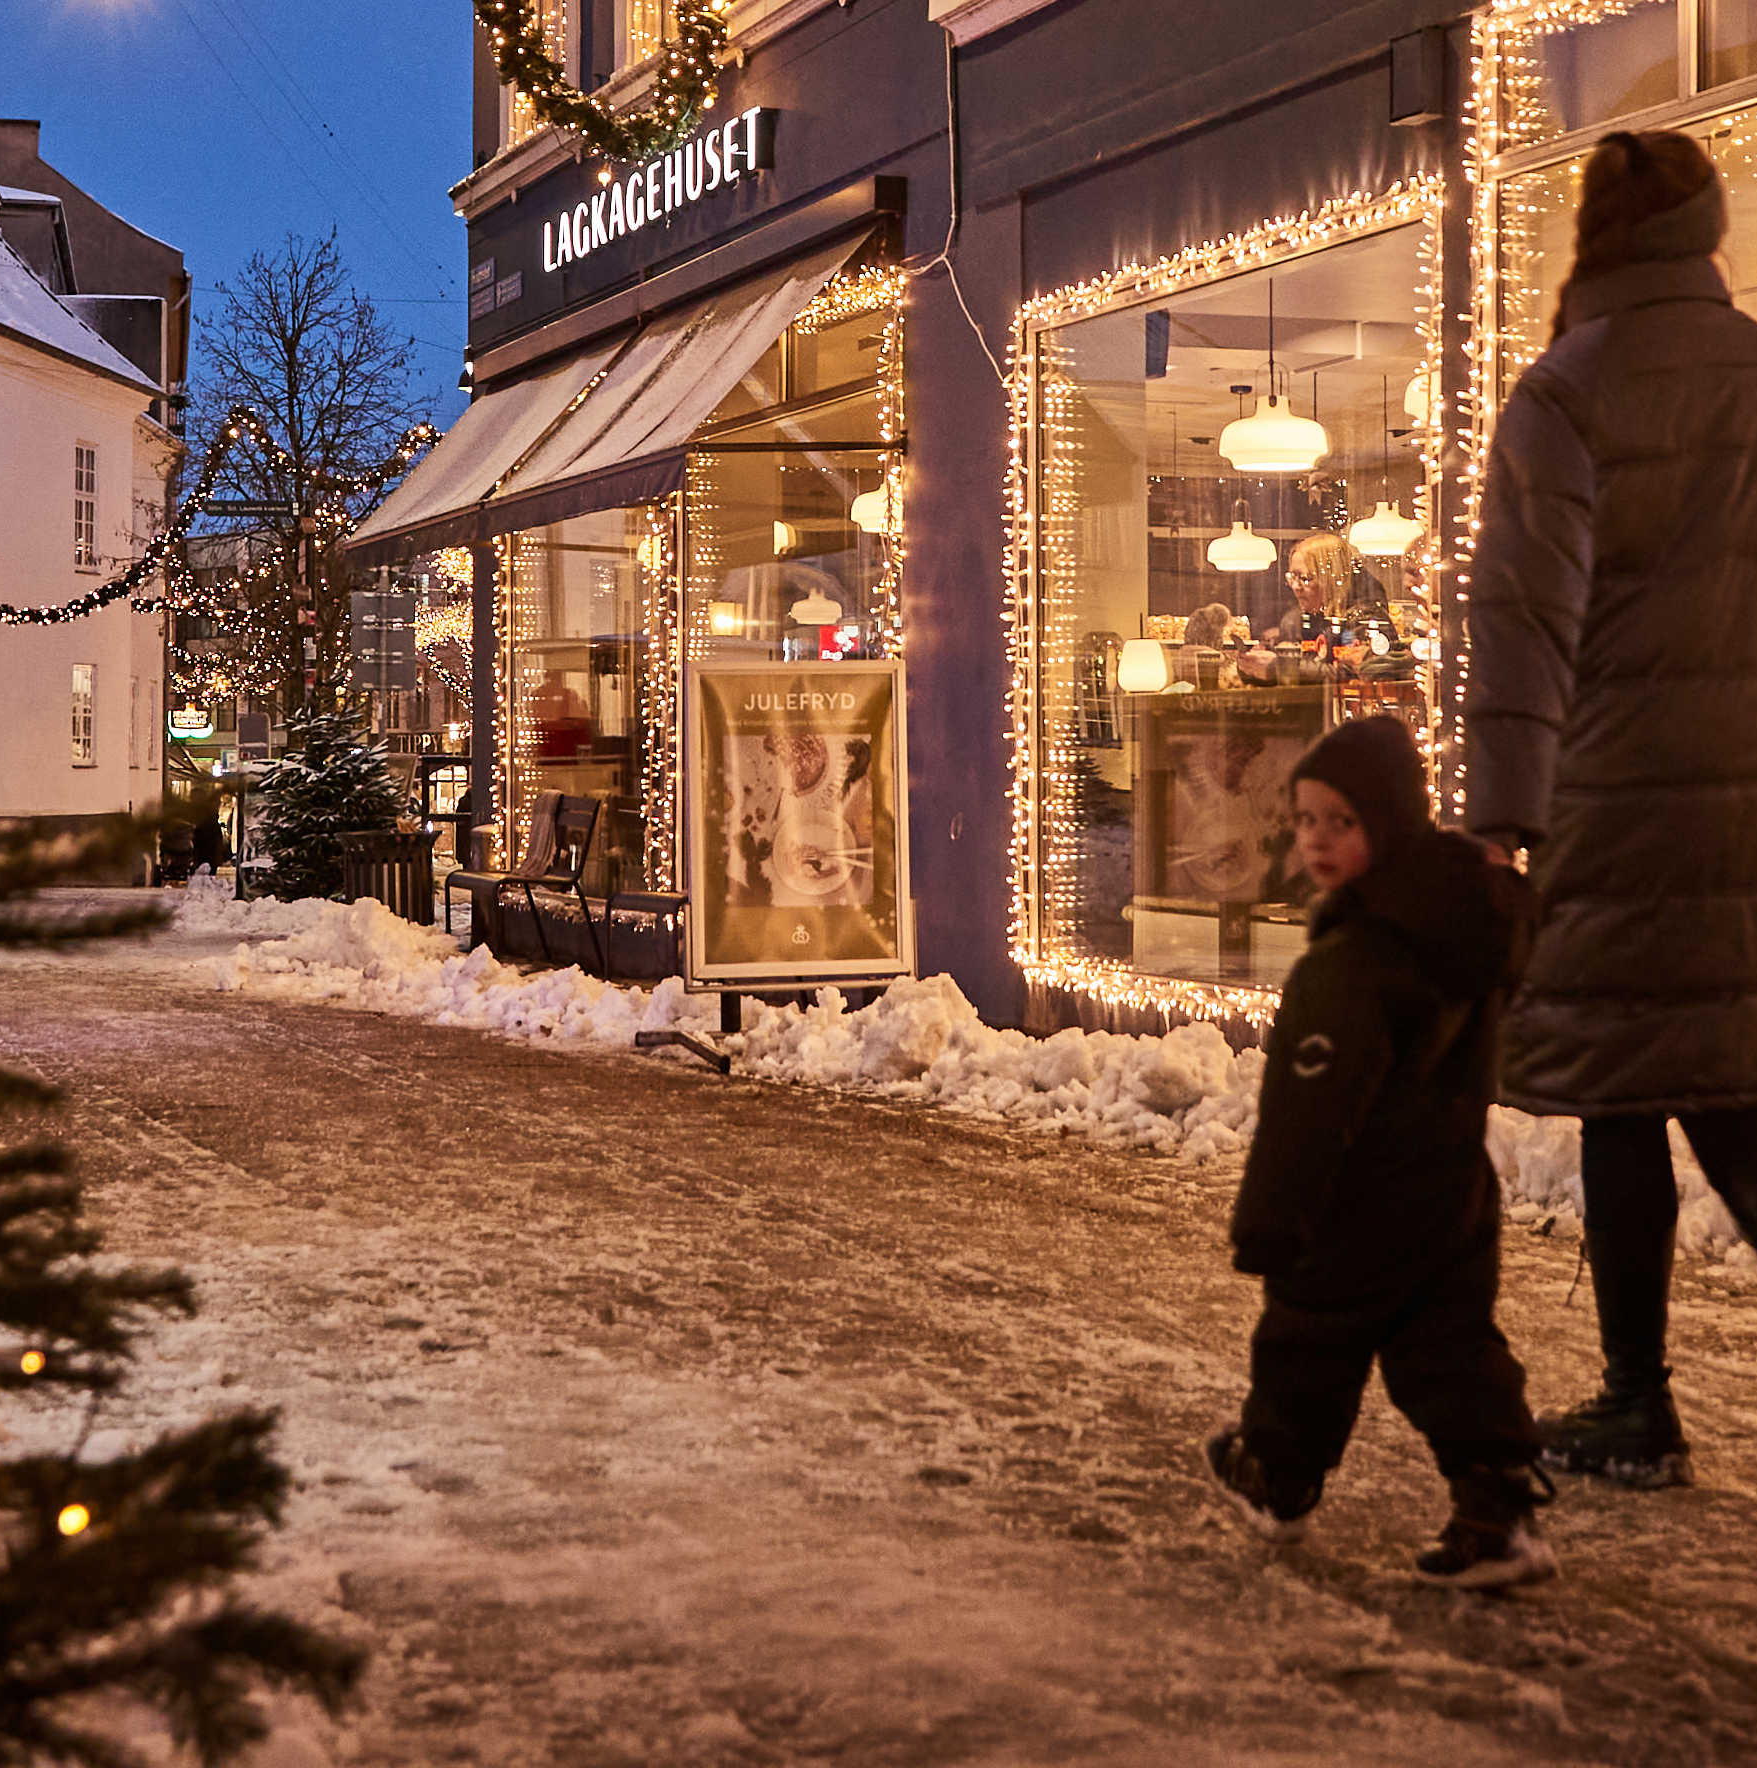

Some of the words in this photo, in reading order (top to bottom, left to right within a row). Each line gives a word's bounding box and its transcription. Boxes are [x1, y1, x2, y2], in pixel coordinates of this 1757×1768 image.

[543, 105, 762, 273] LAGKAGEHUSET
[744, 692, 856, 711] JULEFRYD
[397, 733, 442, 753] TIPPY
